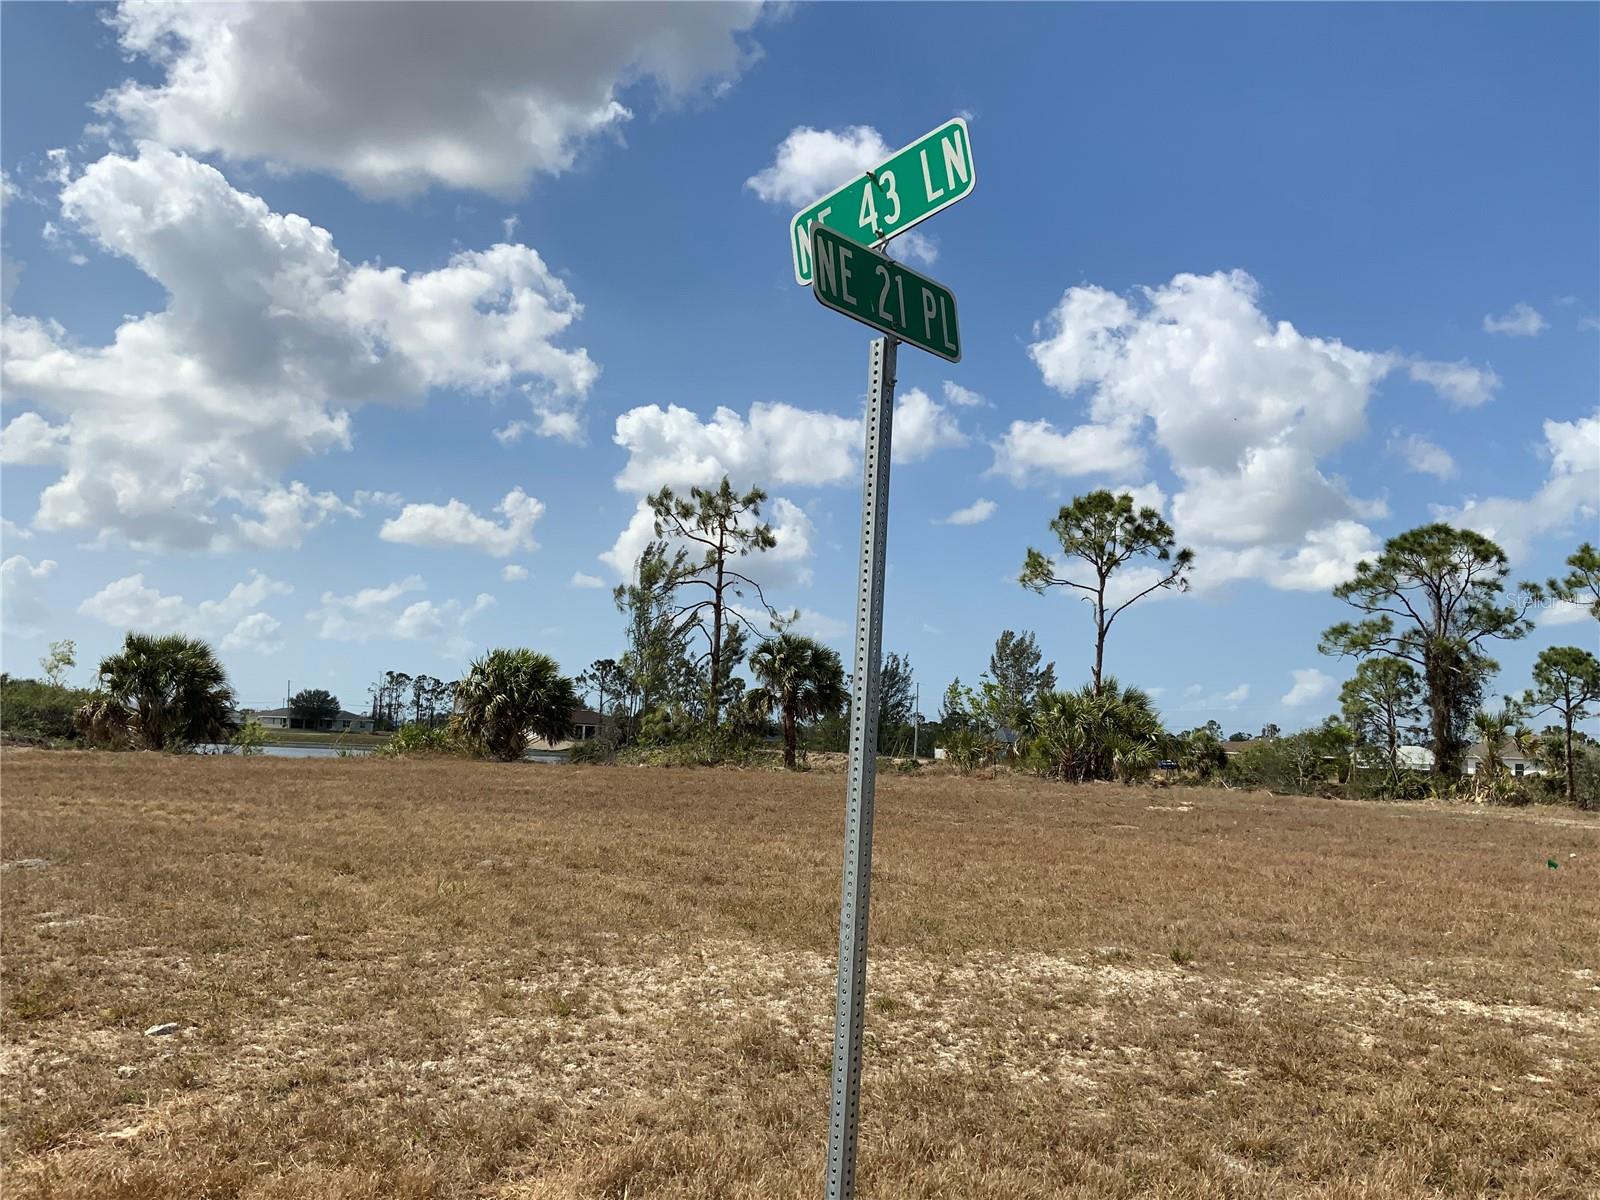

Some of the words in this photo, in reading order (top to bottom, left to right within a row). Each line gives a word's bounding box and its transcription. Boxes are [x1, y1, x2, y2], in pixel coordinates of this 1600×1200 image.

[858, 170, 900, 234] 43
[920, 130, 968, 203] LN
[816, 235, 857, 305] NE
[875, 264, 907, 328] 21
[921, 287, 957, 351] PL
